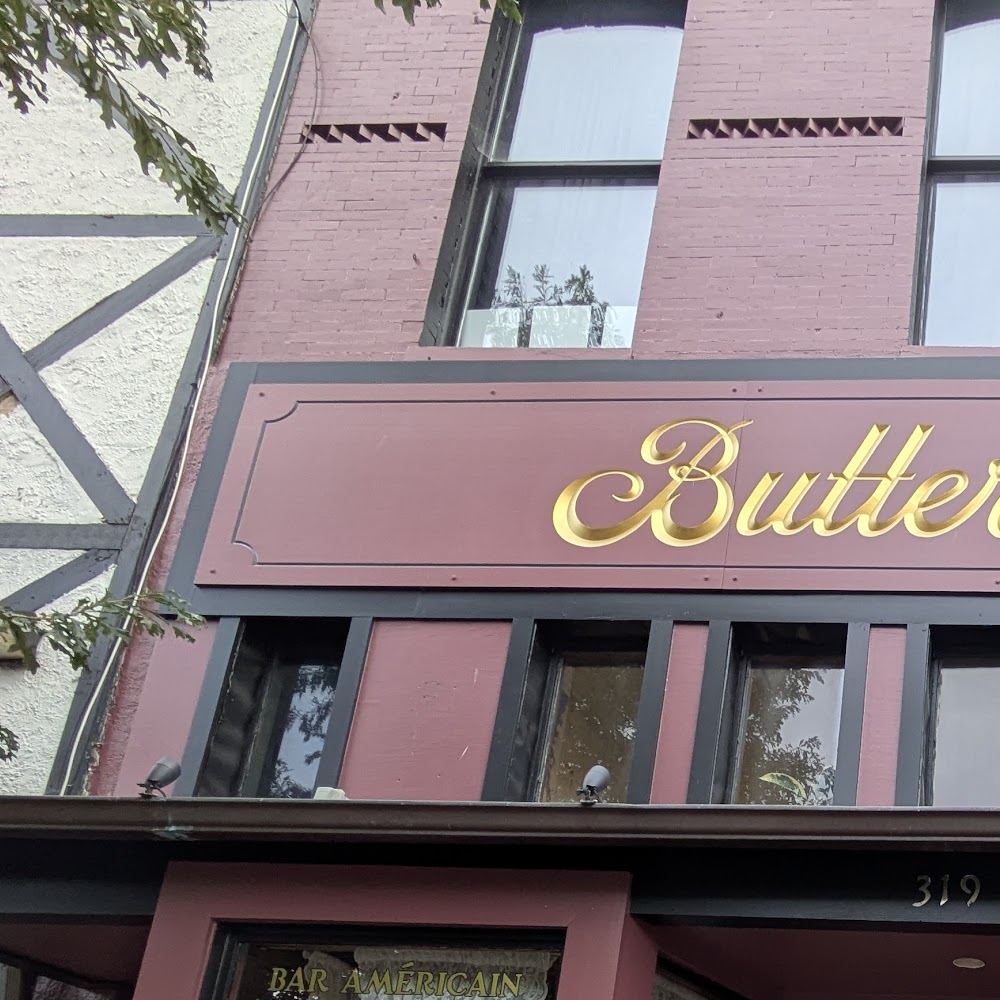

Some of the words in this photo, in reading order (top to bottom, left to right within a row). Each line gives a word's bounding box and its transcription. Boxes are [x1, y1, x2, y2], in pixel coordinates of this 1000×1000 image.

[911, 874, 981, 907] 319
[268, 967, 330, 993] BAR
[341, 961, 522, 998] AMÉRICAIN
